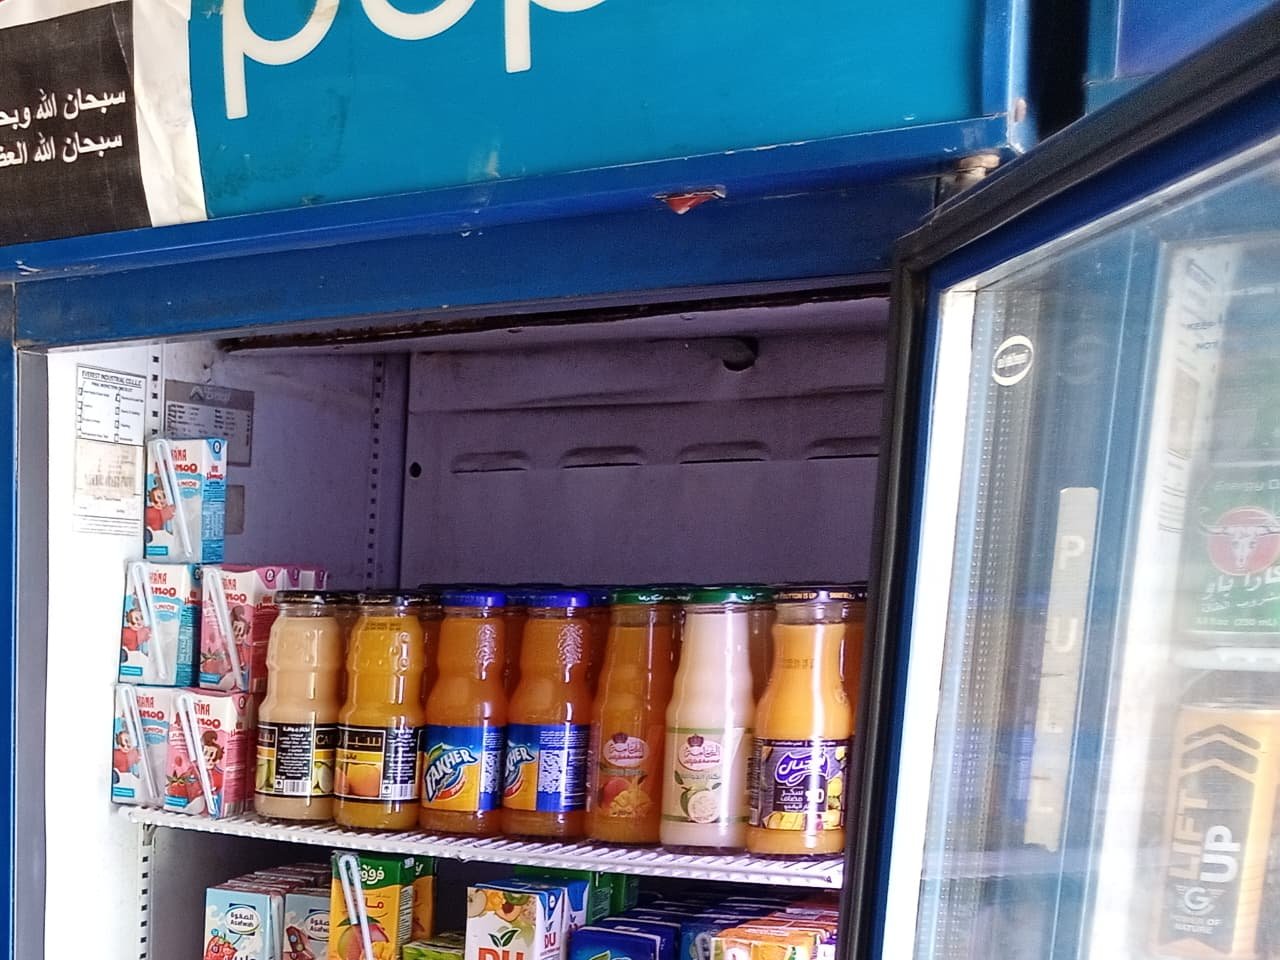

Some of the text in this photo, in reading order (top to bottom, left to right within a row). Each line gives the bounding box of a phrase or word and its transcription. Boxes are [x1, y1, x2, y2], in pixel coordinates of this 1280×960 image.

[35, 88, 58, 120] الله
[64, 88, 126, 120] سبحان
[33, 131, 56, 162] الله
[62, 131, 123, 163] سبحان
[1199, 825, 1242, 884] UP
